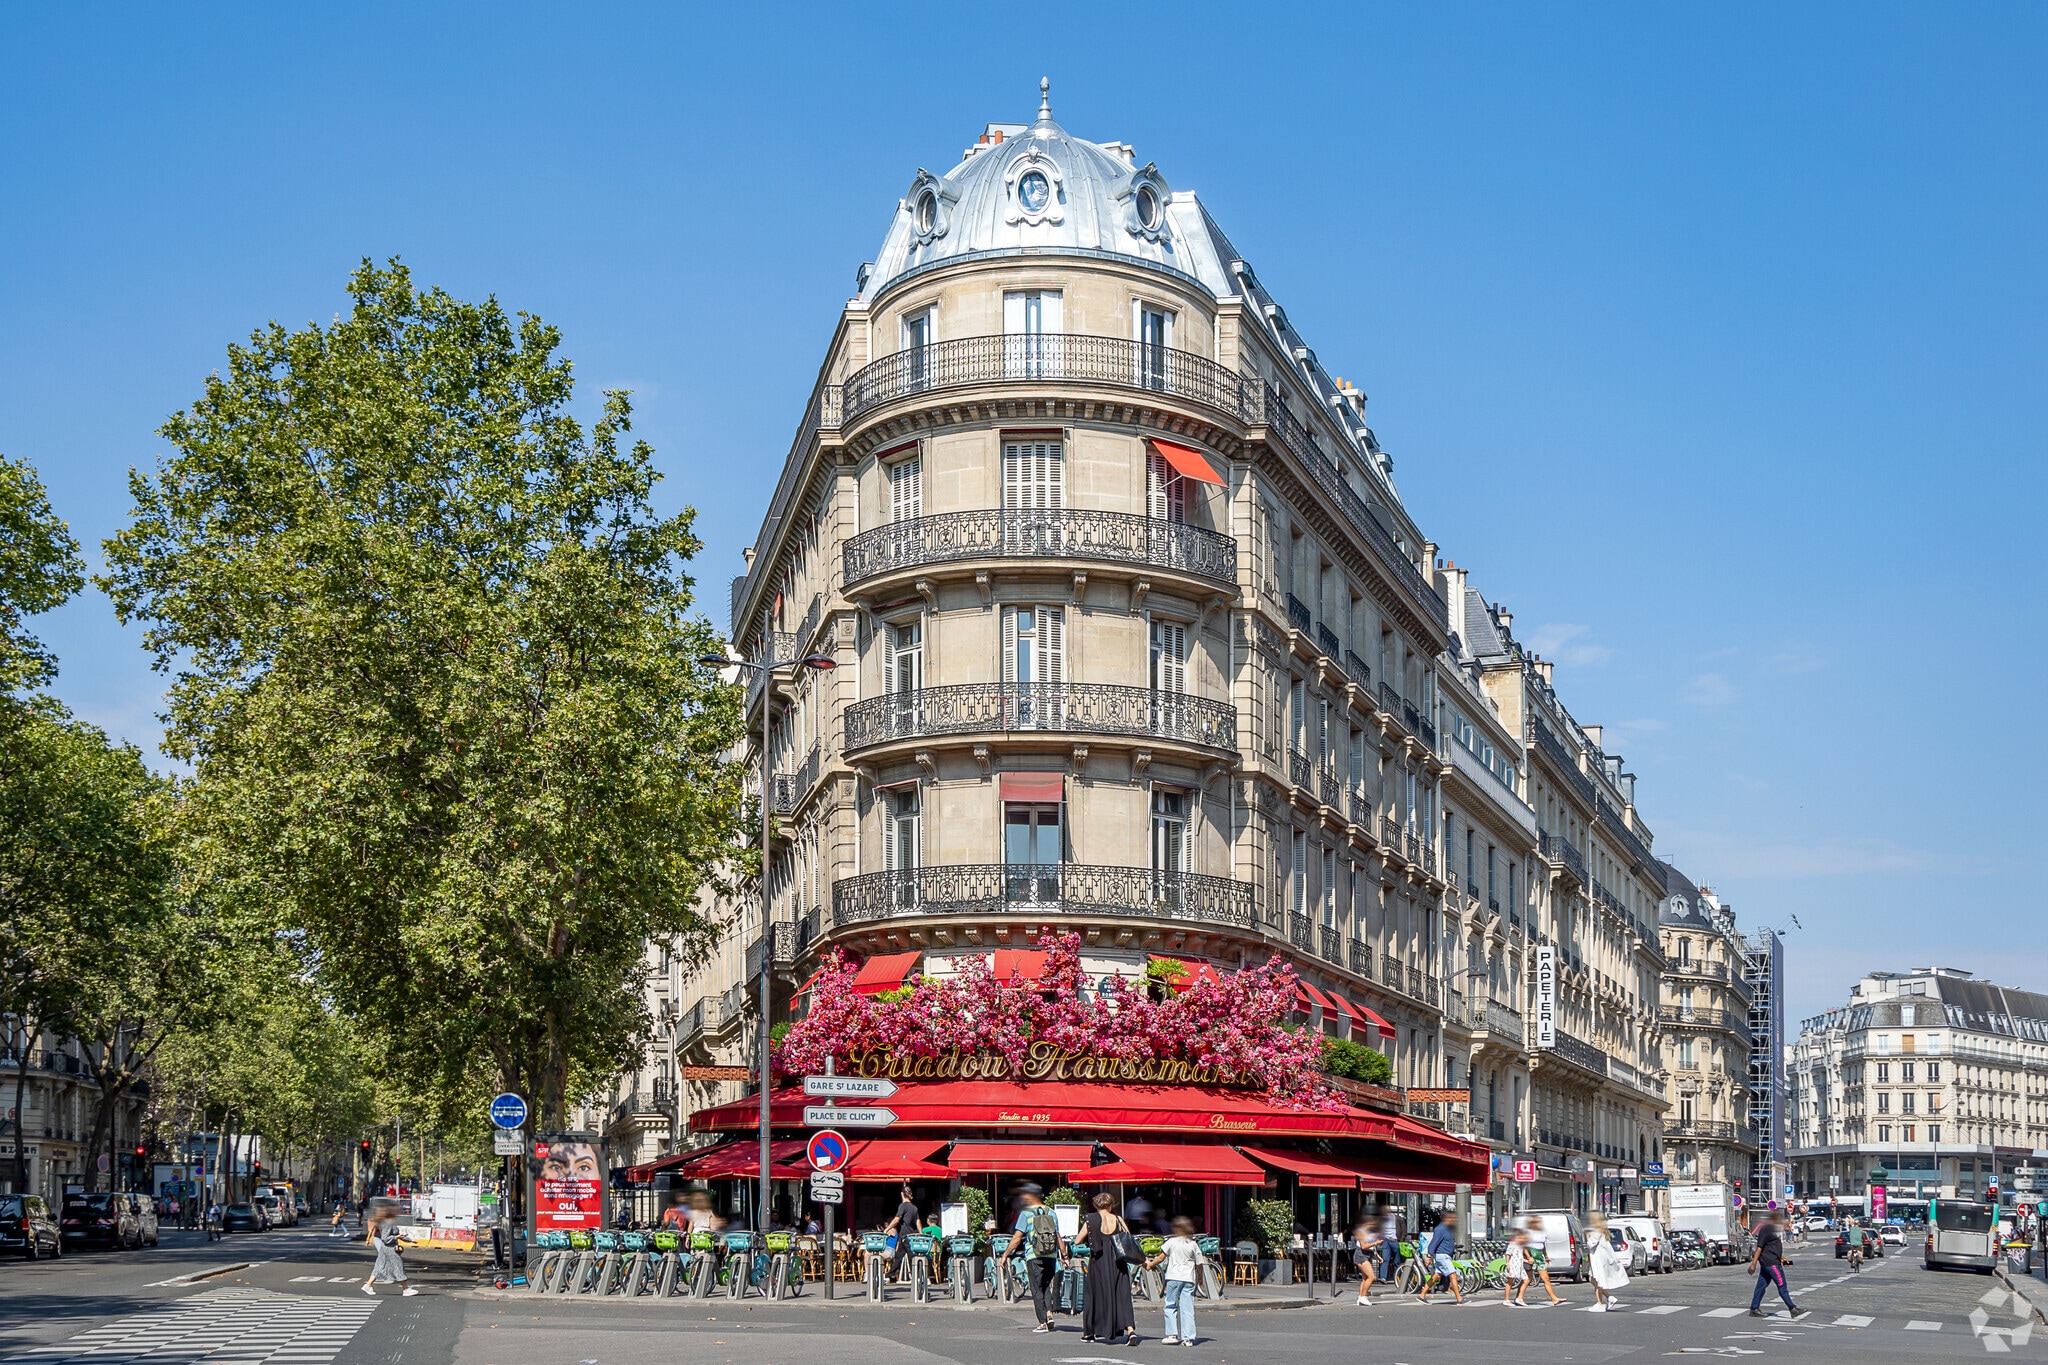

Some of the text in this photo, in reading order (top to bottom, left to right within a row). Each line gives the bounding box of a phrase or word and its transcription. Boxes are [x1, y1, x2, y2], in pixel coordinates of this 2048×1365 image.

[1540, 952, 1551, 1041] PAPETERIE
[684, 1066, 749, 1080] BRASSERIE
[810, 1082, 833, 1090] GARE
[846, 1083, 880, 1092] LAZARE
[1409, 1090, 1468, 1102] BRASSERIE
[810, 1112, 876, 1121] PLACE DE CLICHY
[1031, 1113, 1051, 1122] 1935
[1209, 1113, 1257, 1130] Brasserie
[559, 1200, 578, 1212] oui,
